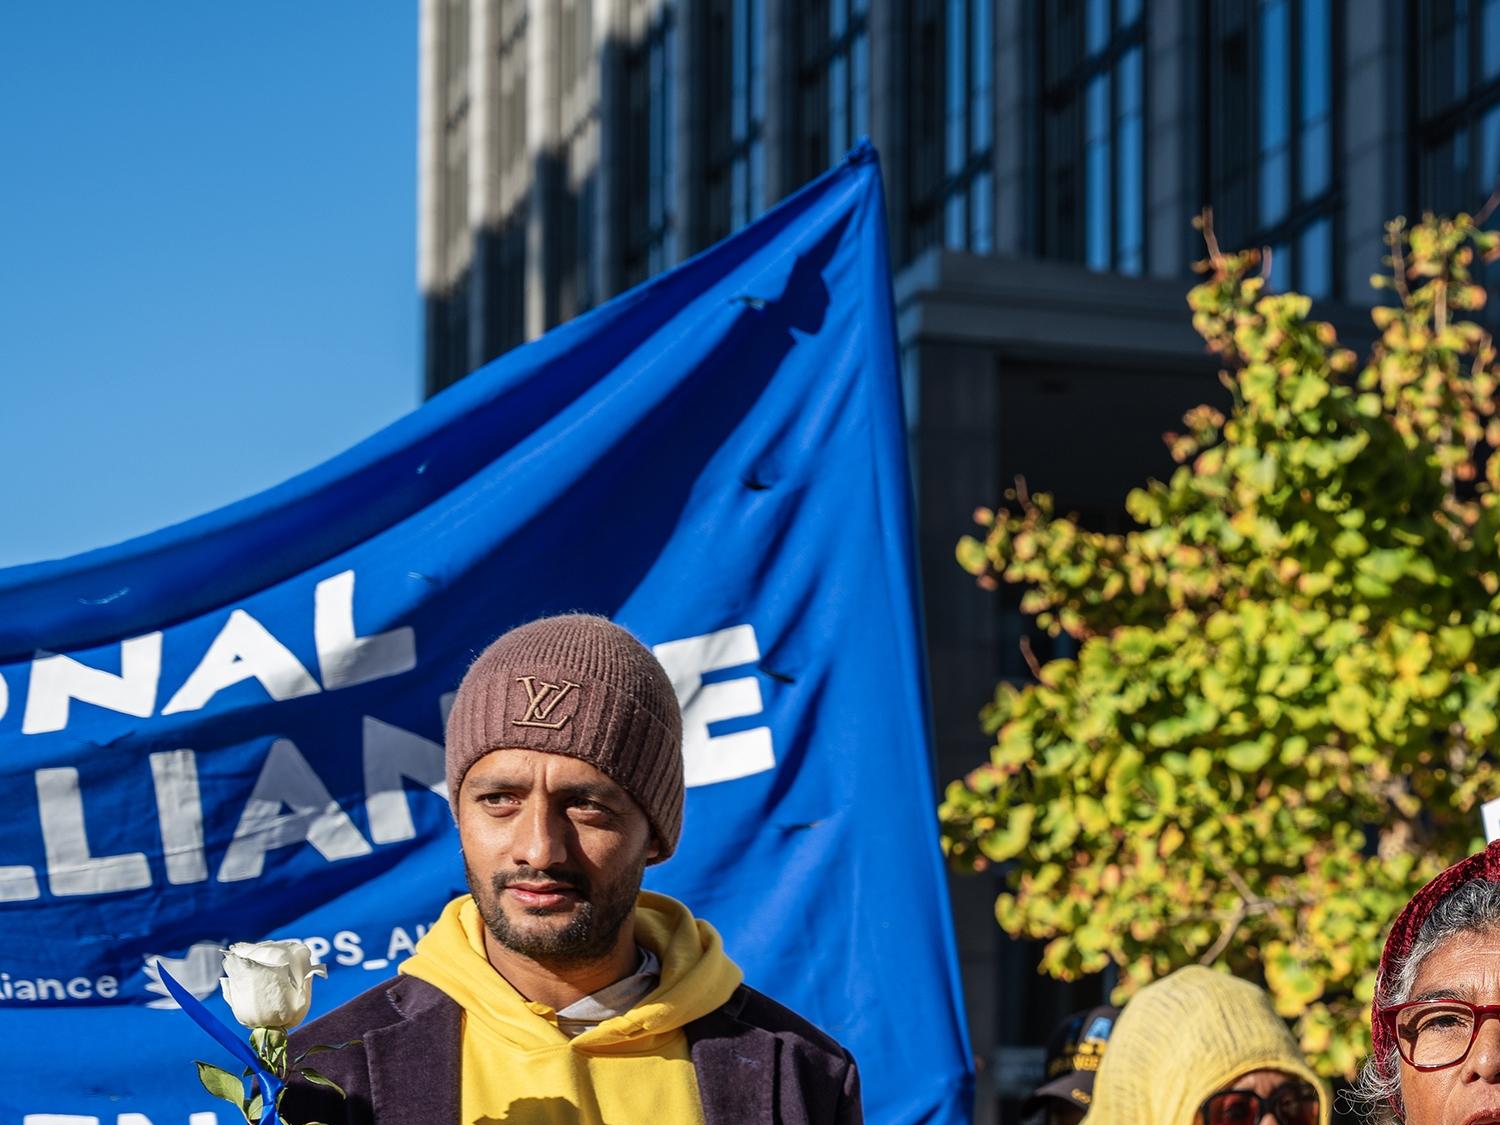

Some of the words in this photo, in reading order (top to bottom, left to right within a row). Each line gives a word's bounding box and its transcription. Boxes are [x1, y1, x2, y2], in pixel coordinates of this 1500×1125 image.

[0, 570, 417, 735] NAL
[276, 922, 434, 971] PS_A
[0, 971, 119, 1001] iance
